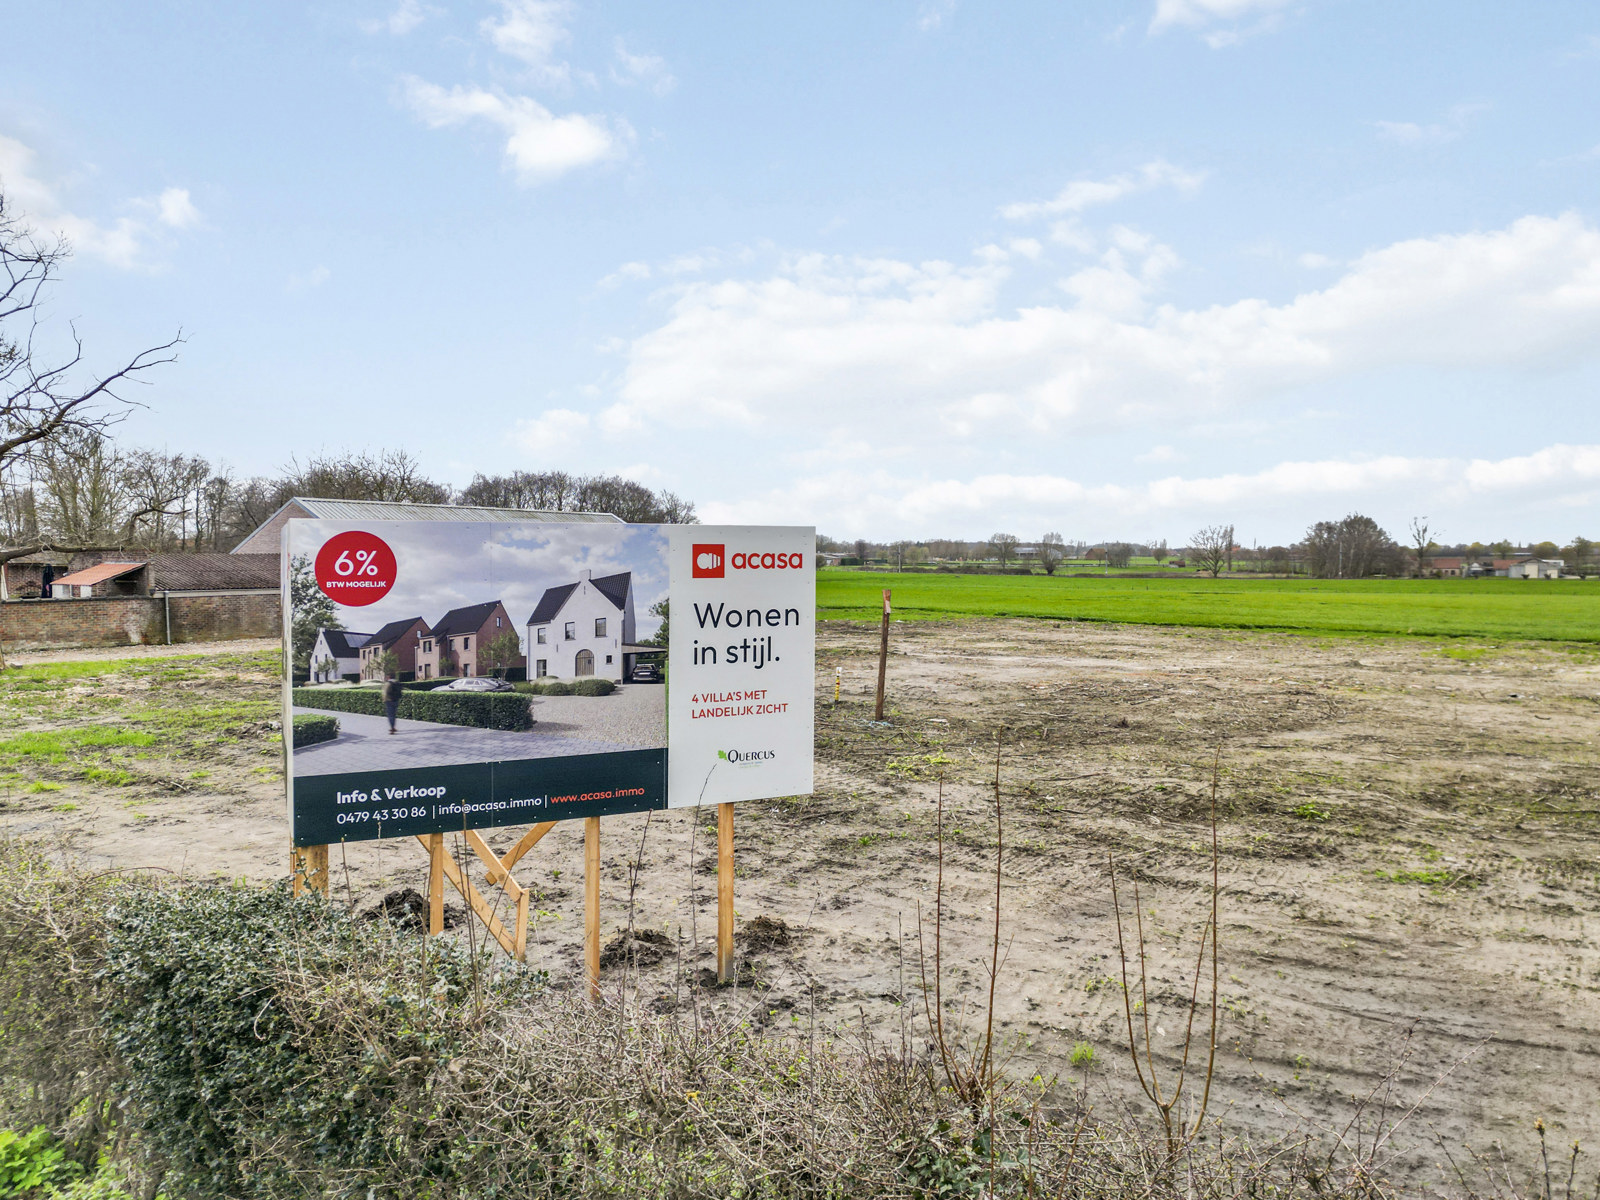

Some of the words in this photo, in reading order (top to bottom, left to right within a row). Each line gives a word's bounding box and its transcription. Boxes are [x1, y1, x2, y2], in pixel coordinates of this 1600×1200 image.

[334, 550, 378, 576] 6%
[731, 552, 803, 570] acasa
[345, 580, 386, 588] MOGELIJK
[693, 602, 799, 629] Wonen
[693, 639, 717, 665] in
[725, 636, 780, 670] stijl.
[691, 693, 699, 703] 4
[701, 691, 742, 703] VILLA'S
[744, 689, 767, 701] MET
[691, 705, 754, 719] LANDELIJK
[756, 703, 788, 715] ZICHT
[336, 790, 368, 804] Info
[370, 788, 382, 801] &
[384, 785, 447, 798] Verkoop
[336, 810, 370, 825] 0479
[372, 808, 390, 821] 43
[391, 807, 409, 820] 30
[410, 806, 427, 818] 86
[438, 797, 542, 815] info@acasa.immo
[550, 787, 645, 803] www.acasa.immo
